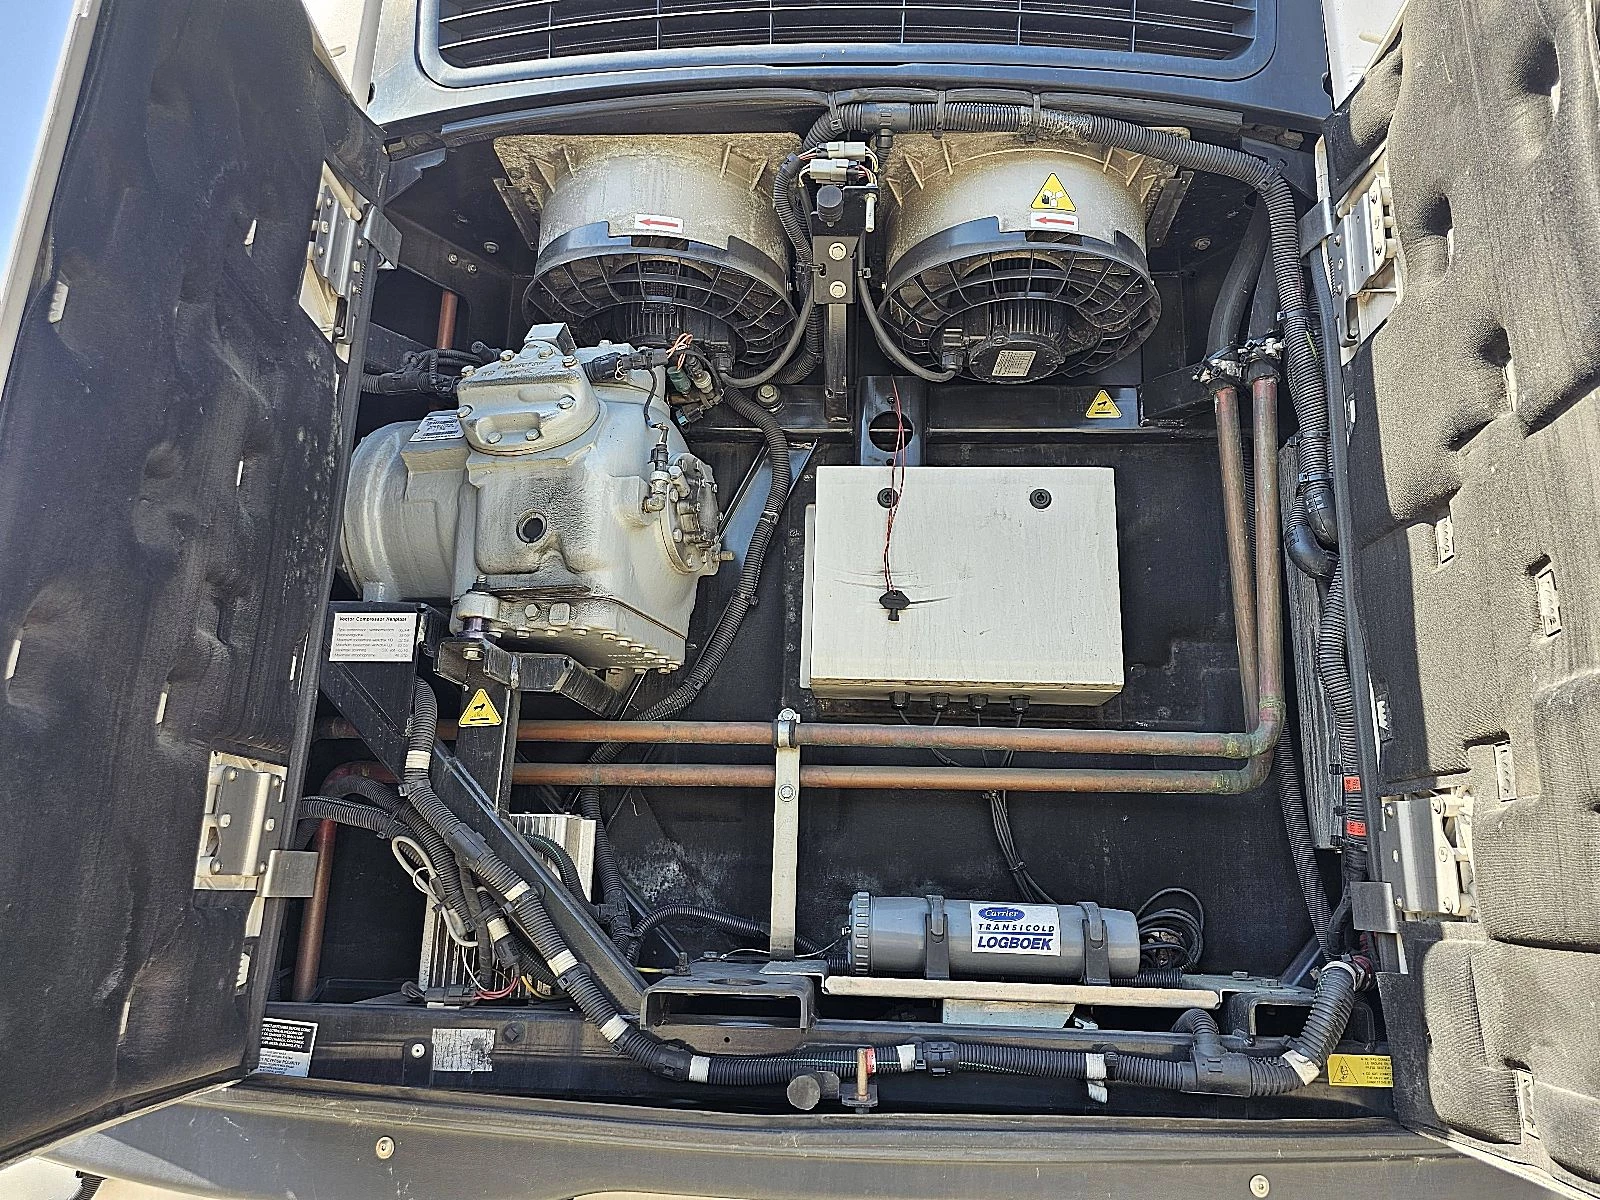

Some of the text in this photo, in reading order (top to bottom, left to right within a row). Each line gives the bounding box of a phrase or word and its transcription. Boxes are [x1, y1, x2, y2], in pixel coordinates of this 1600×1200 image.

[985, 909, 1019, 917] Carrier
[978, 923, 1055, 932] TRANSICOLD
[977, 936, 1053, 951] LOGBOEK
